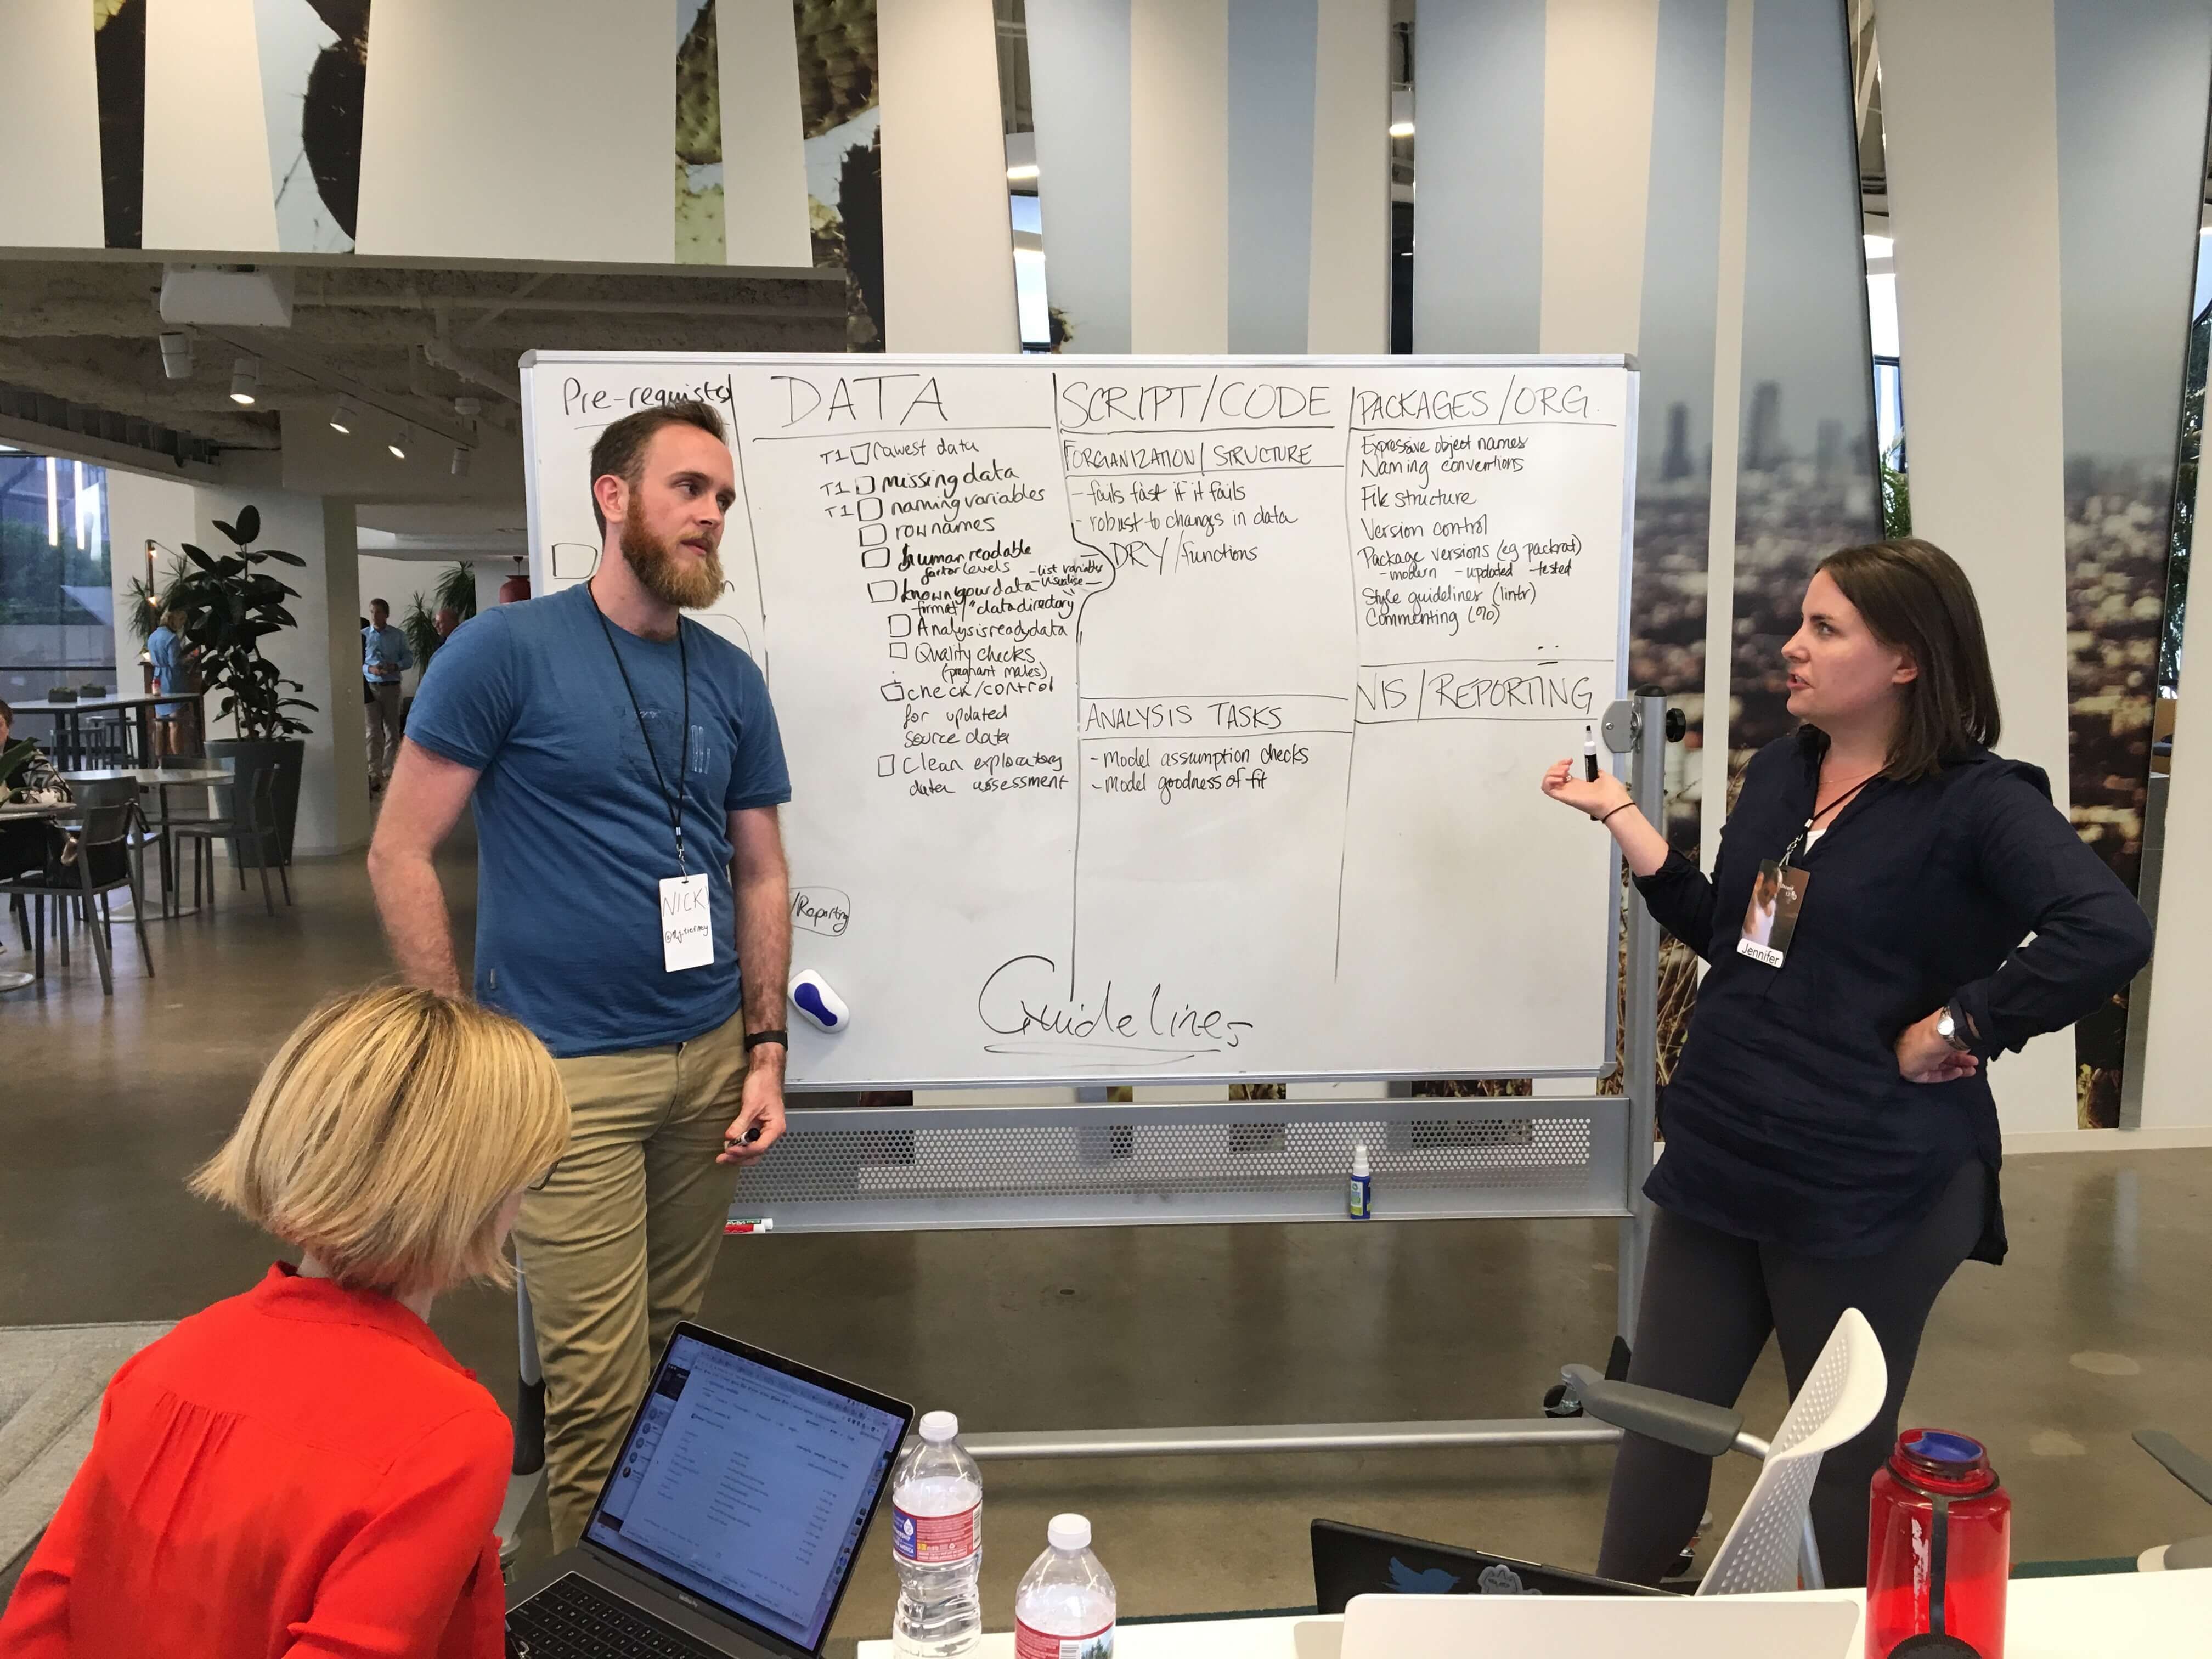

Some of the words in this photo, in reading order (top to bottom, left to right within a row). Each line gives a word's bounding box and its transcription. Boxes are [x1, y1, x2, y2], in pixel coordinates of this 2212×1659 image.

[771, 374, 948, 428] DATA
[937, 438, 979, 455] data
[1362, 433, 1430, 456] Expressive
[1435, 435, 1471, 459] object
[1477, 436, 1529, 450] names
[882, 470, 958, 498] missing
[963, 459, 1019, 483] data
[1361, 459, 1430, 489] Naming
[1441, 455, 1525, 472] conventions
[891, 498, 961, 522] naming
[964, 483, 1045, 508] variables
[1087, 479, 1125, 505] fails
[1130, 481, 1167, 501] fast
[1172, 481, 1187, 502] if
[1192, 481, 1204, 502] it
[1209, 481, 1246, 502] fails
[1362, 484, 1390, 511] File
[1395, 489, 1477, 508] structure
[1090, 505, 1145, 532] robust
[1145, 511, 1160, 530] to
[1233, 509, 1246, 526] in
[1254, 505, 1299, 525] data
[1361, 518, 1424, 540] Version
[1433, 513, 1487, 536] control
[969, 539, 1032, 561] readable
[1357, 546, 1425, 570] Package
[1431, 544, 1490, 561] versions
[963, 560, 1010, 574] levels
[993, 577, 1038, 596] data
[1362, 587, 1401, 615] Style
[1408, 584, 1483, 614] guidelines
[1031, 619, 1068, 637] data
[1365, 604, 1459, 636] Commenting
[916, 643, 971, 668] Quality
[977, 644, 1036, 663] checks
[903, 703, 930, 730] for
[946, 704, 1008, 730] updated
[1085, 703, 1192, 731] ANALYSIS
[1208, 702, 1282, 730] TASKS
[966, 727, 1010, 746] data
[974, 752, 1063, 775] exploratory
[1161, 747, 1250, 771] assumption
[1260, 744, 1309, 764] checks
[910, 778, 956, 796] data
[973, 775, 1069, 792] assessment
[1158, 770, 1222, 805] goodness
[1226, 767, 1246, 788] of
[1246, 768, 1267, 789] fit
[662, 888, 706, 917] NICK
[1742, 943, 1780, 965] Jennifer
[979, 955, 1253, 1047] Guidelines
